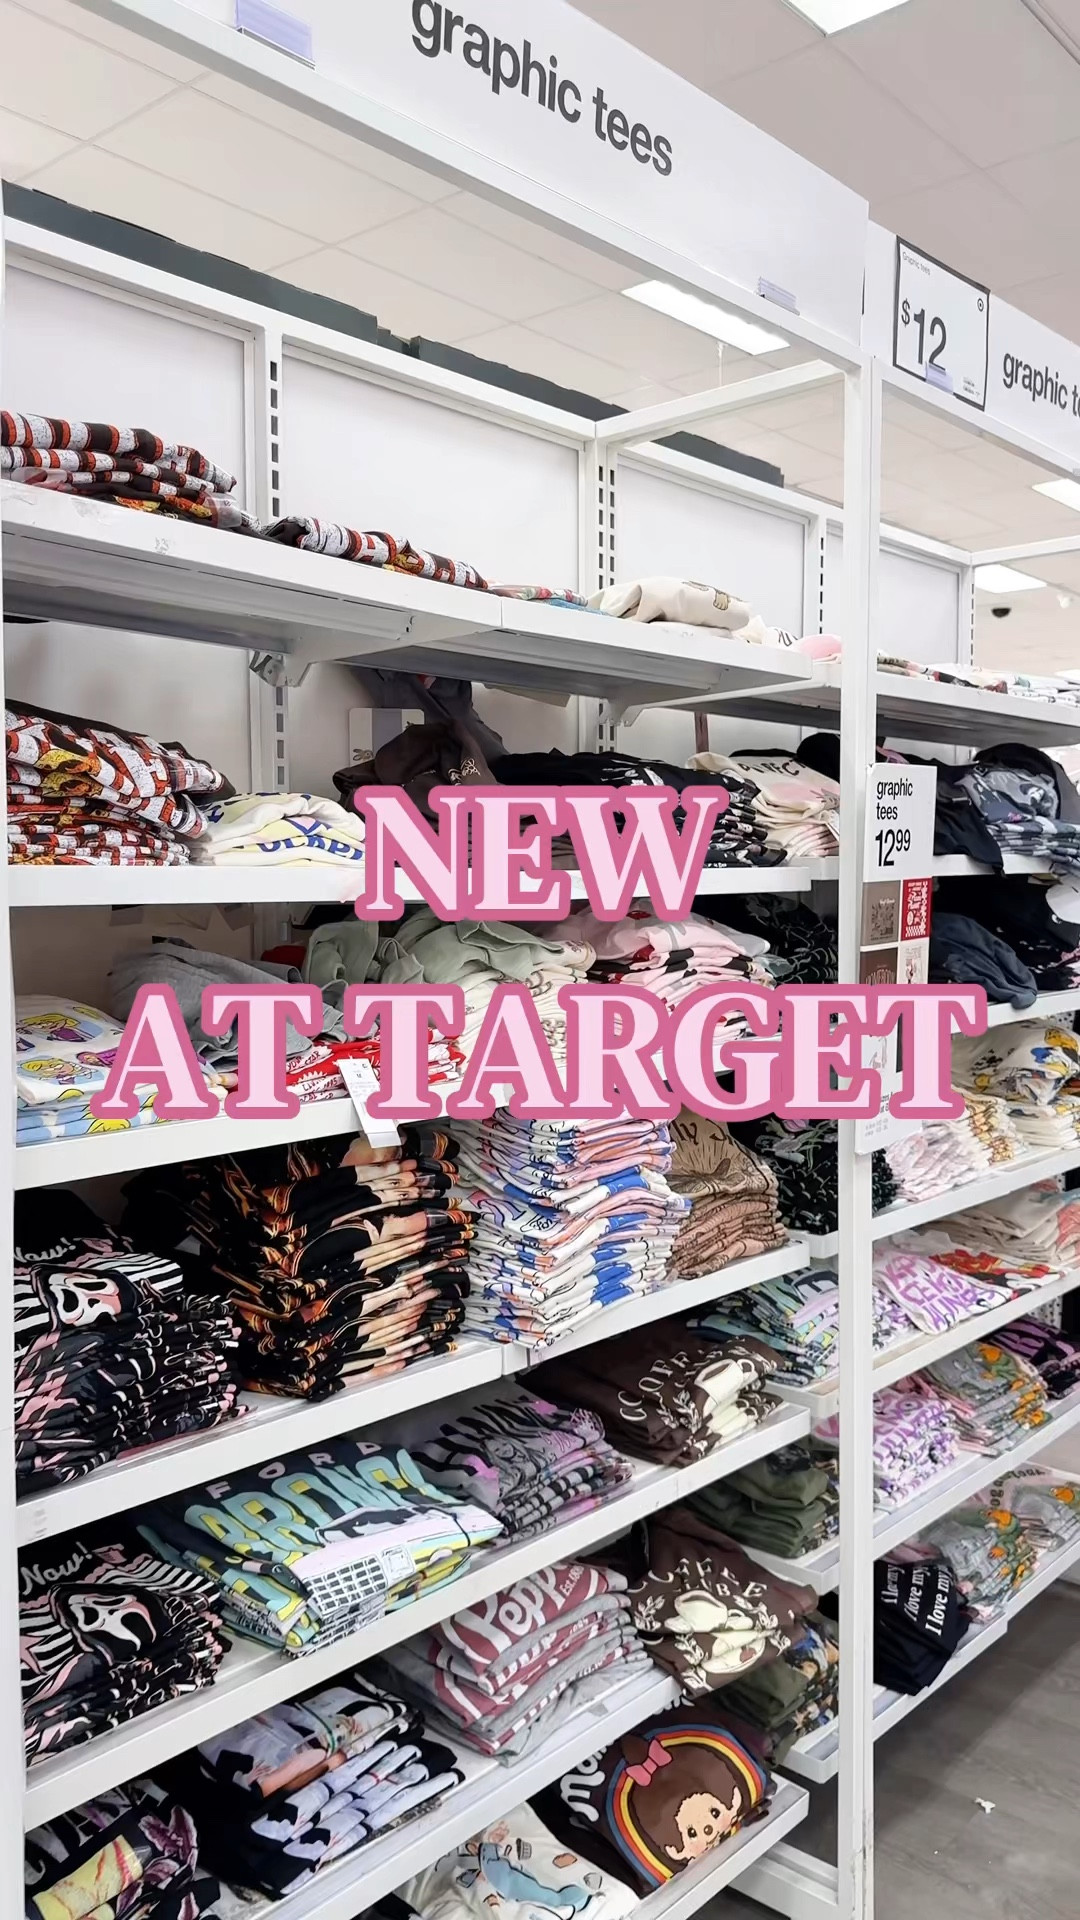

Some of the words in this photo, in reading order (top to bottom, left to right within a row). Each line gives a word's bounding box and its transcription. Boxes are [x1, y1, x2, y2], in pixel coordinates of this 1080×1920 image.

[412, 0, 582, 123] graphic
[592, 87, 672, 176] tees
[1003, 352, 1068, 410] graphic
[876, 778, 913, 800] graphic
[876, 803, 898, 820] tees
[204, 1441, 382, 1500] FORD
[20, 1541, 93, 1596] Now!
[937, 1565, 956, 1593] my
[904, 1586, 922, 1616] love
[927, 1593, 948, 1626] love
[925, 1622, 942, 1636] I
